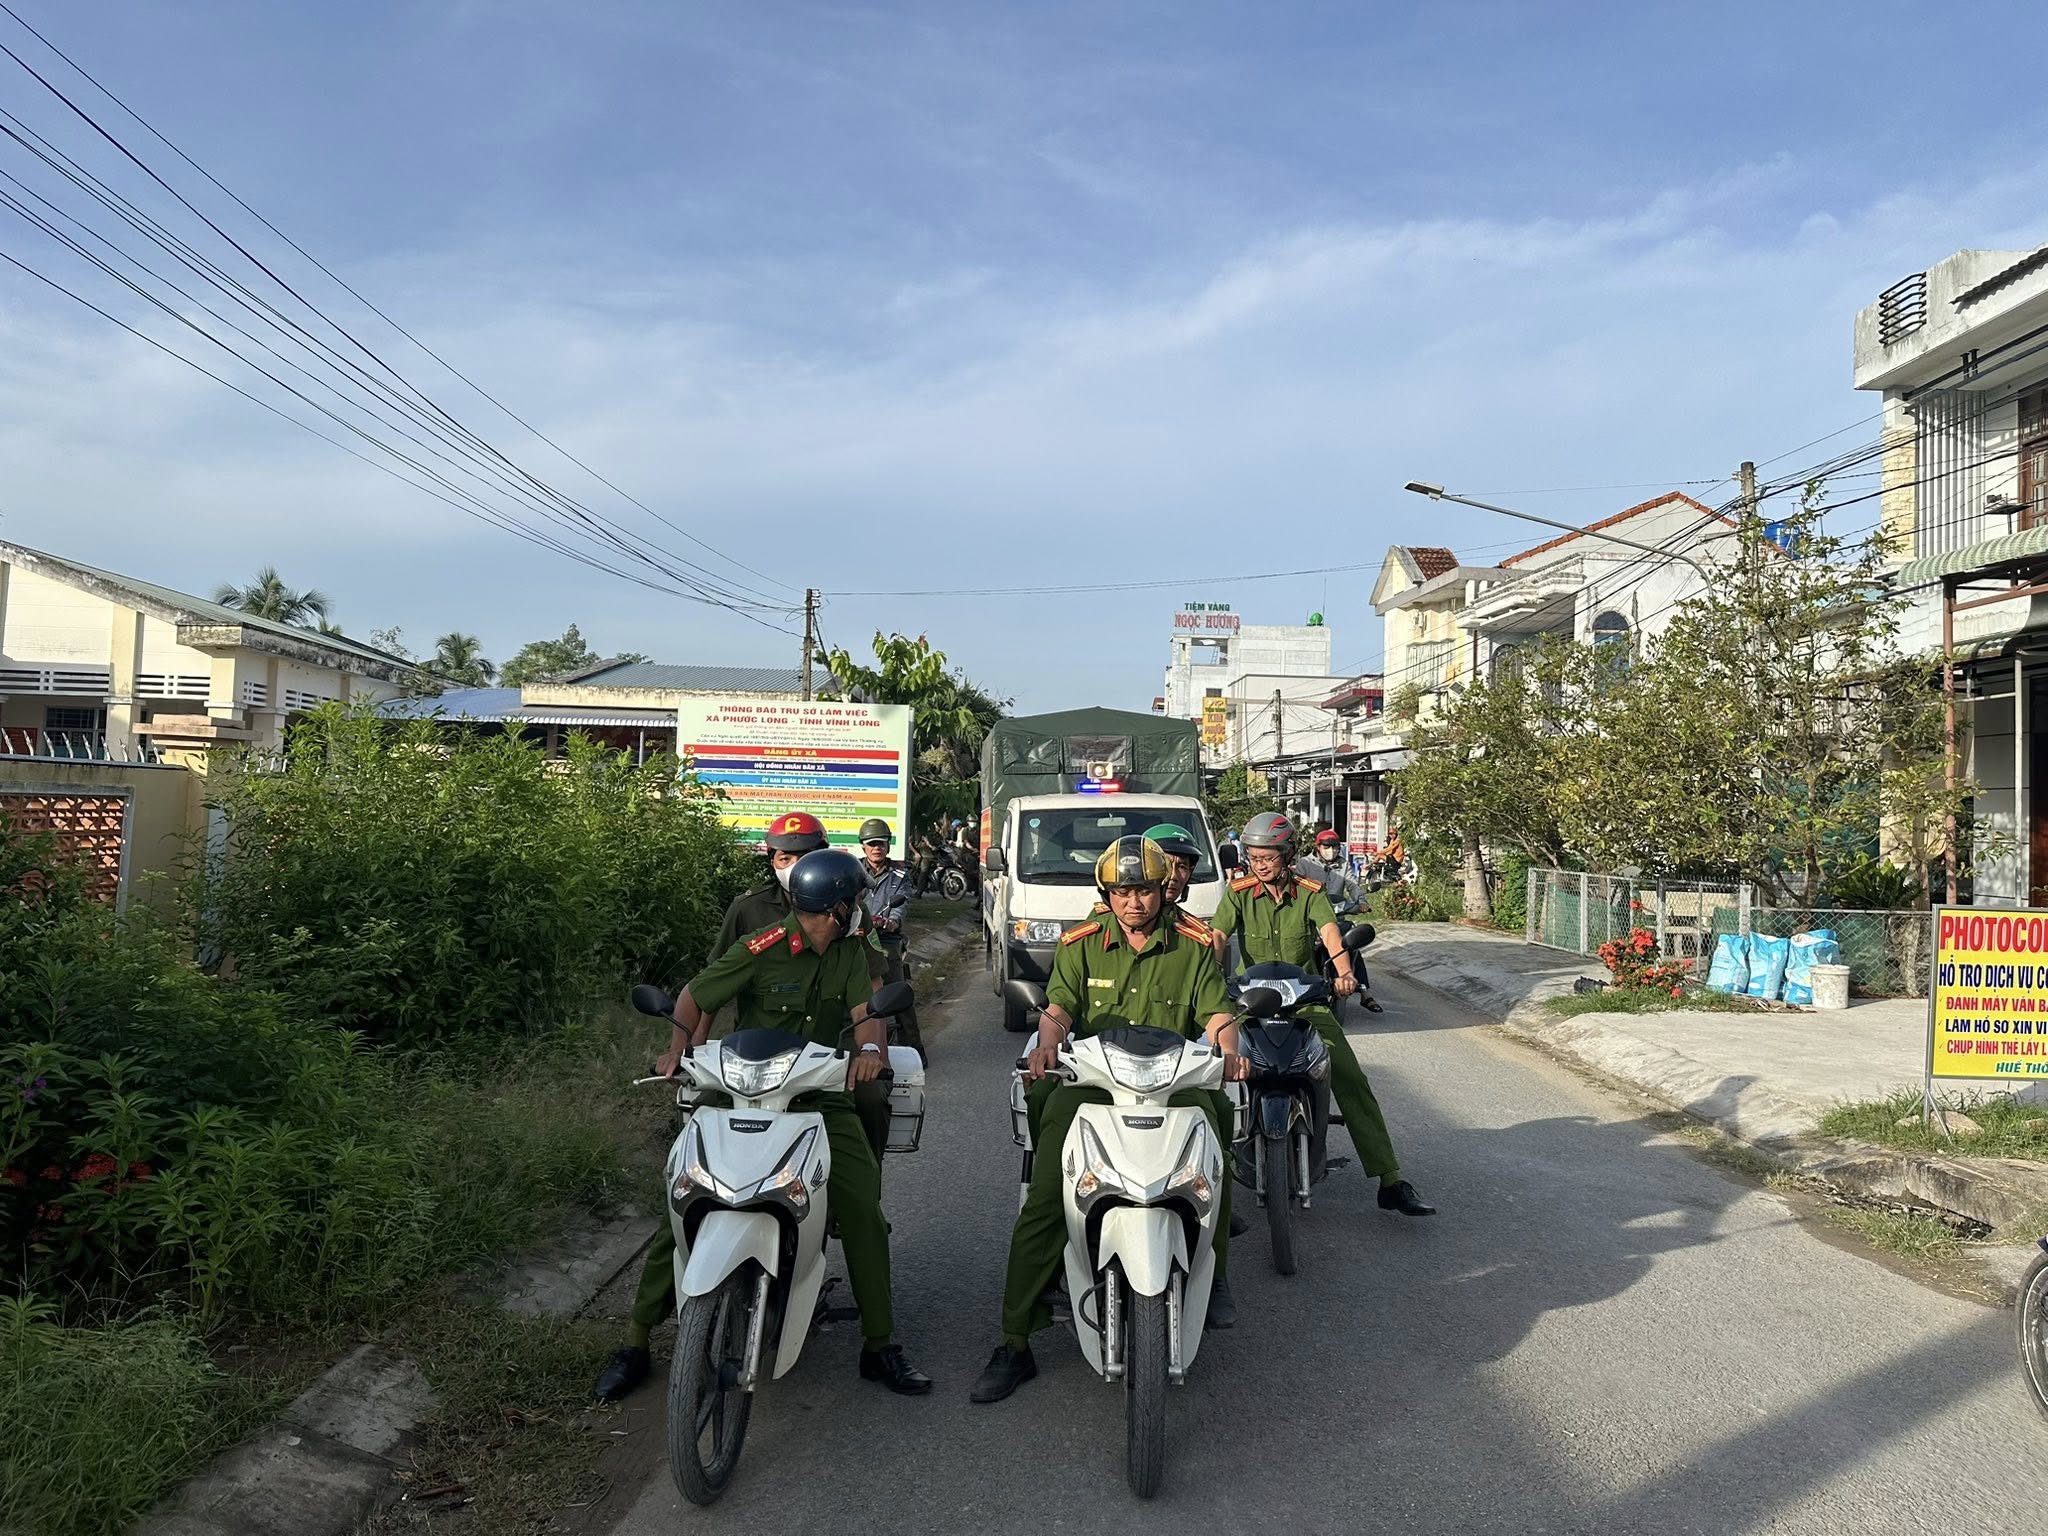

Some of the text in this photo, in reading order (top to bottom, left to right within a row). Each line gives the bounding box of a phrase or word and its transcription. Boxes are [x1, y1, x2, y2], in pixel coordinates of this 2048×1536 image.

[1184, 601, 1230, 612] TIỆM VÀNG
[1175, 614, 1200, 631] NGỌC
[1985, 964, 2014, 992] DỊCH
[2018, 966, 2033, 993] VỤ
[1946, 994, 1978, 1010] ĐÁNH
[1982, 995, 2008, 1011] MÁY
[2012, 996, 2035, 1012] VĂN
[1946, 1016, 1970, 1032] LÀM
[2012, 1021, 2032, 1034] XIN
[1947, 1040, 1973, 1056] CHỤP
[1976, 1038, 1998, 1054] HÌNH
[2021, 1037, 2039, 1056] LẤY
[1996, 1060, 2022, 1072] HUẾ
